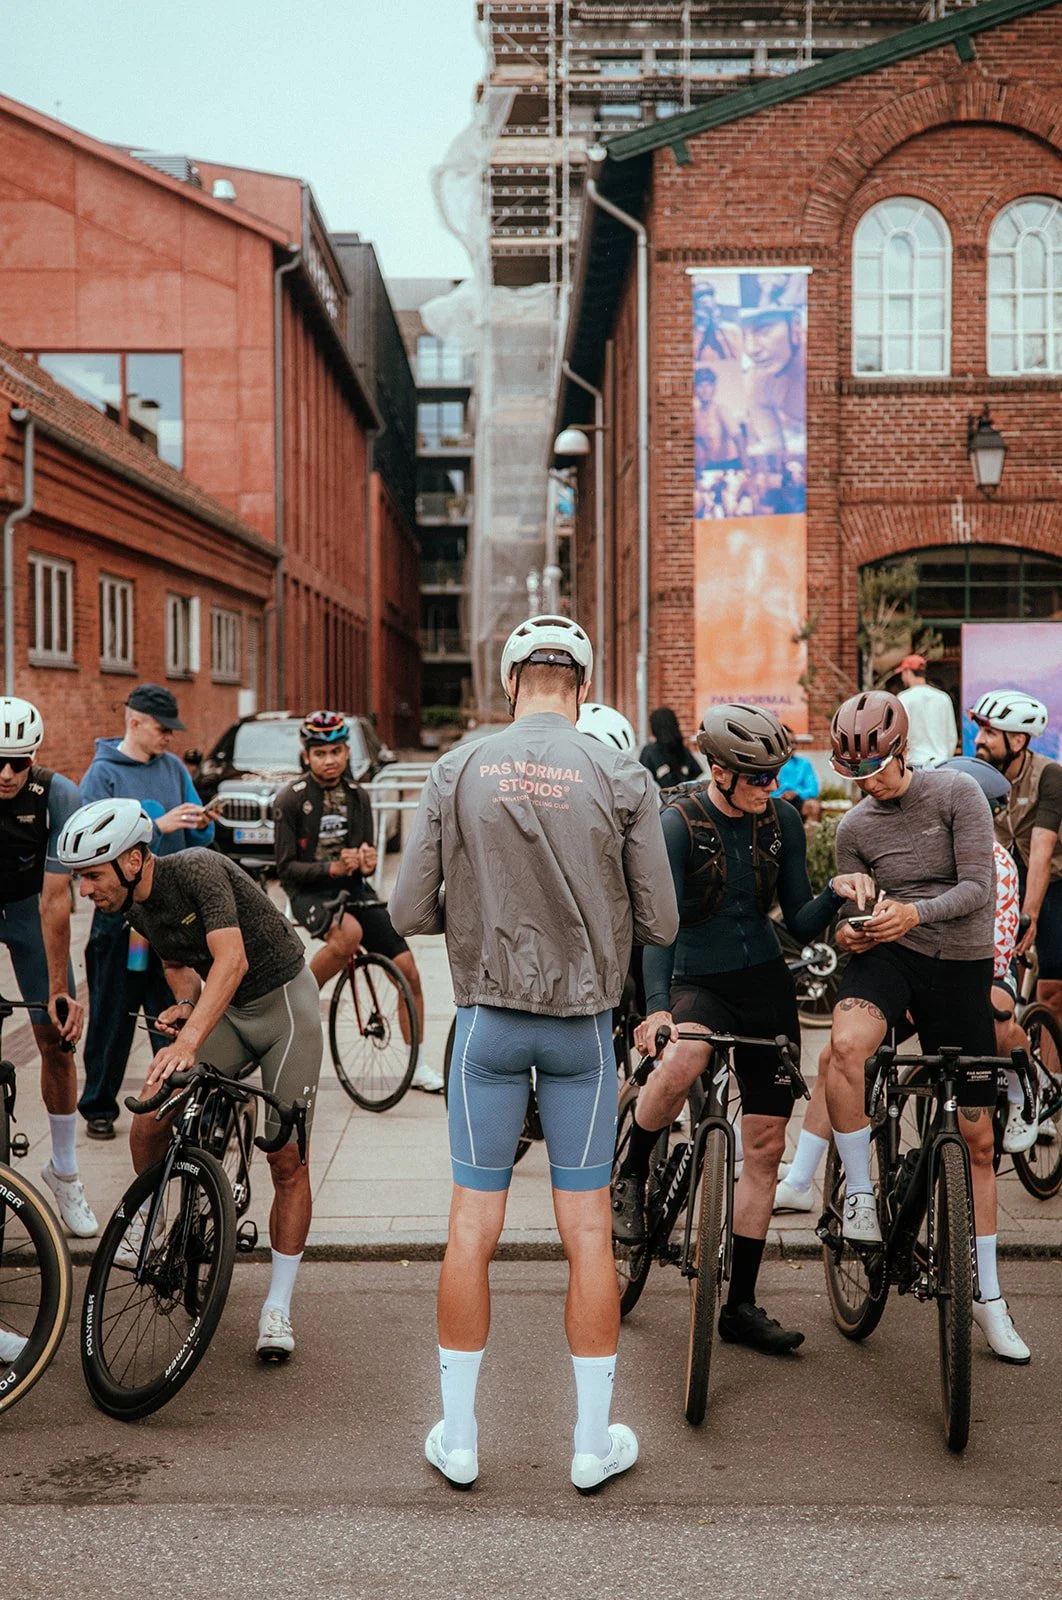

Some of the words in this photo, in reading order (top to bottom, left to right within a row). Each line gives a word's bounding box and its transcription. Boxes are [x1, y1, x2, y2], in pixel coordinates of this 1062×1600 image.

[479, 762, 512, 778] PAS
[514, 761, 583, 783] NORMAL
[86, 1294, 95, 1356] POLYMER
[165, 1316, 201, 1379] POLYMER
